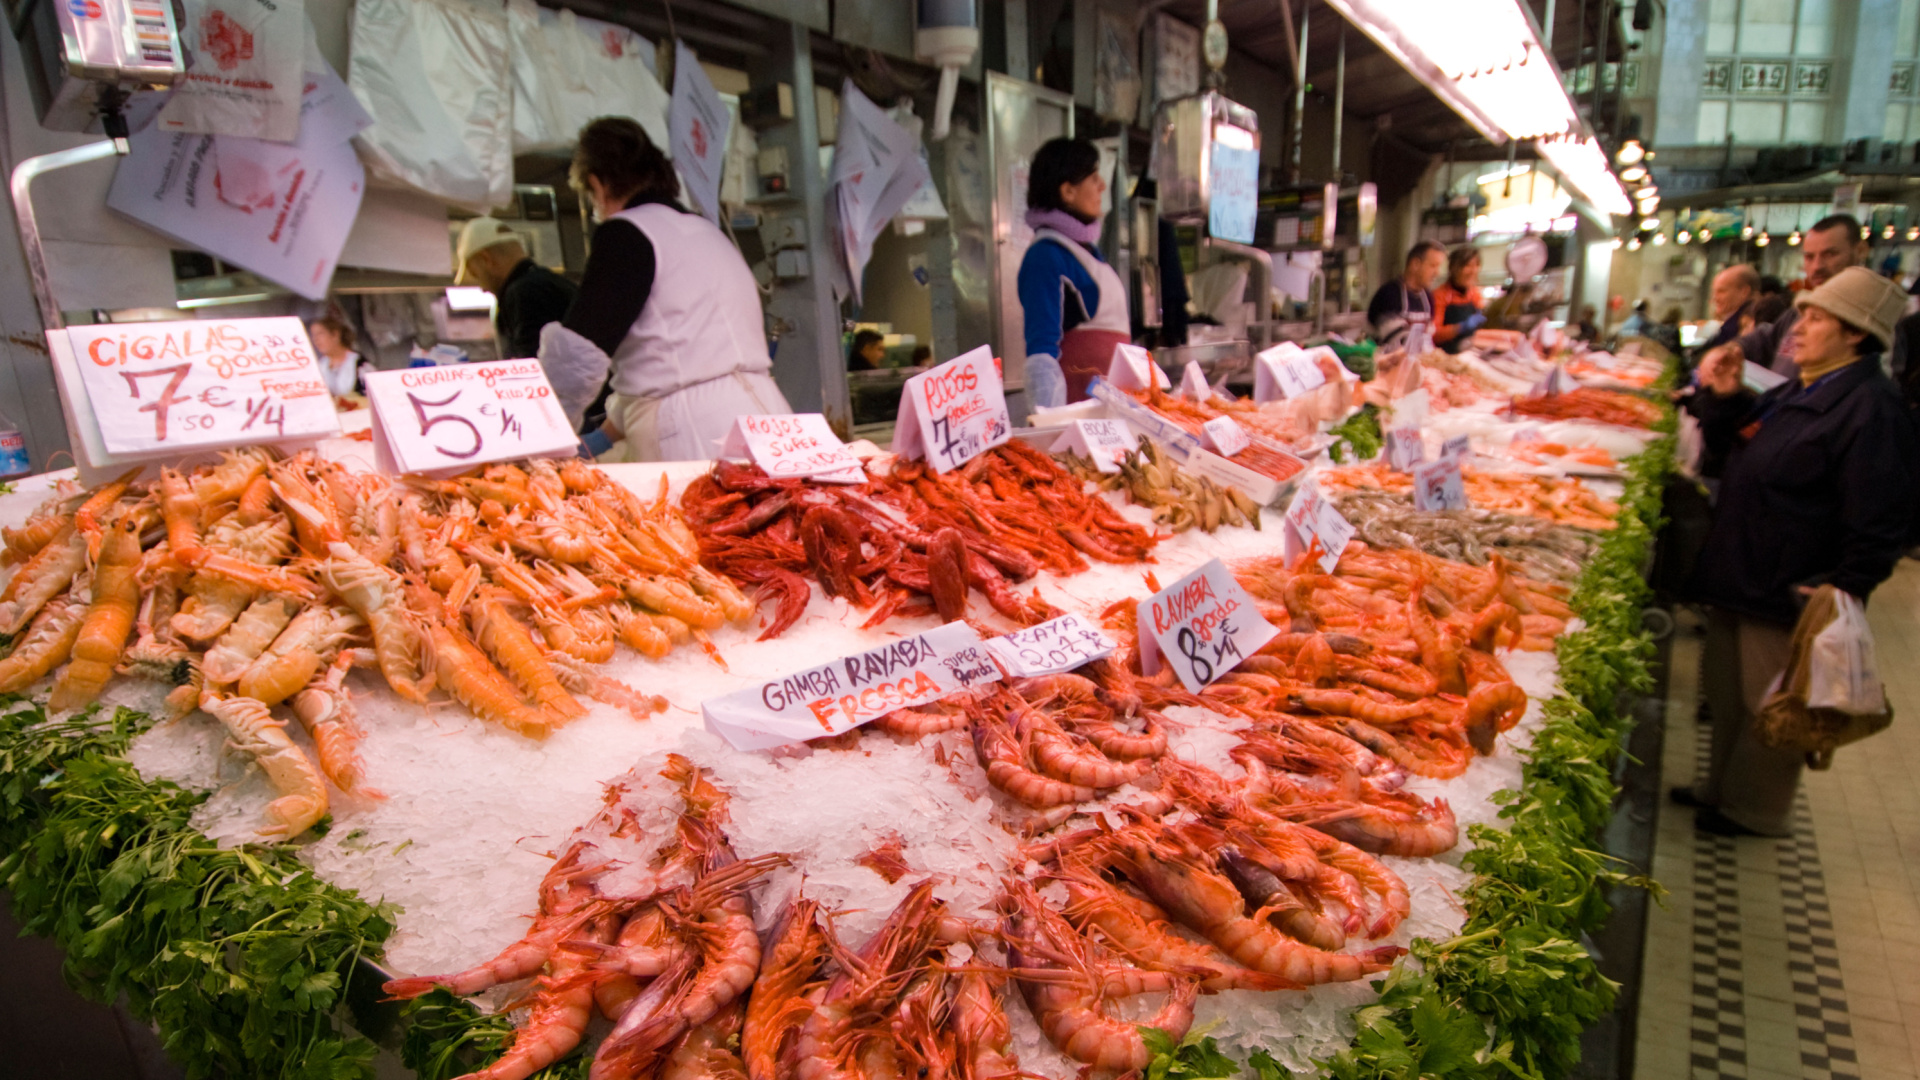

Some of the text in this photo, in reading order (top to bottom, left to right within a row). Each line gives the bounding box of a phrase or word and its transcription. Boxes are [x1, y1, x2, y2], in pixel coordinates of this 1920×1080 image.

[478, 363, 540, 388] gordas
[524, 385, 550, 400] 20
[118, 362, 236, 442] 7 €
[240, 396, 285, 438] 1/4
[406, 389, 522, 459] 5 € 1/4
[931, 414, 960, 467] 7
[1082, 421, 1117, 437] BOCAS
[1177, 626, 1214, 686] 8
[761, 666, 842, 712] GAMBA
